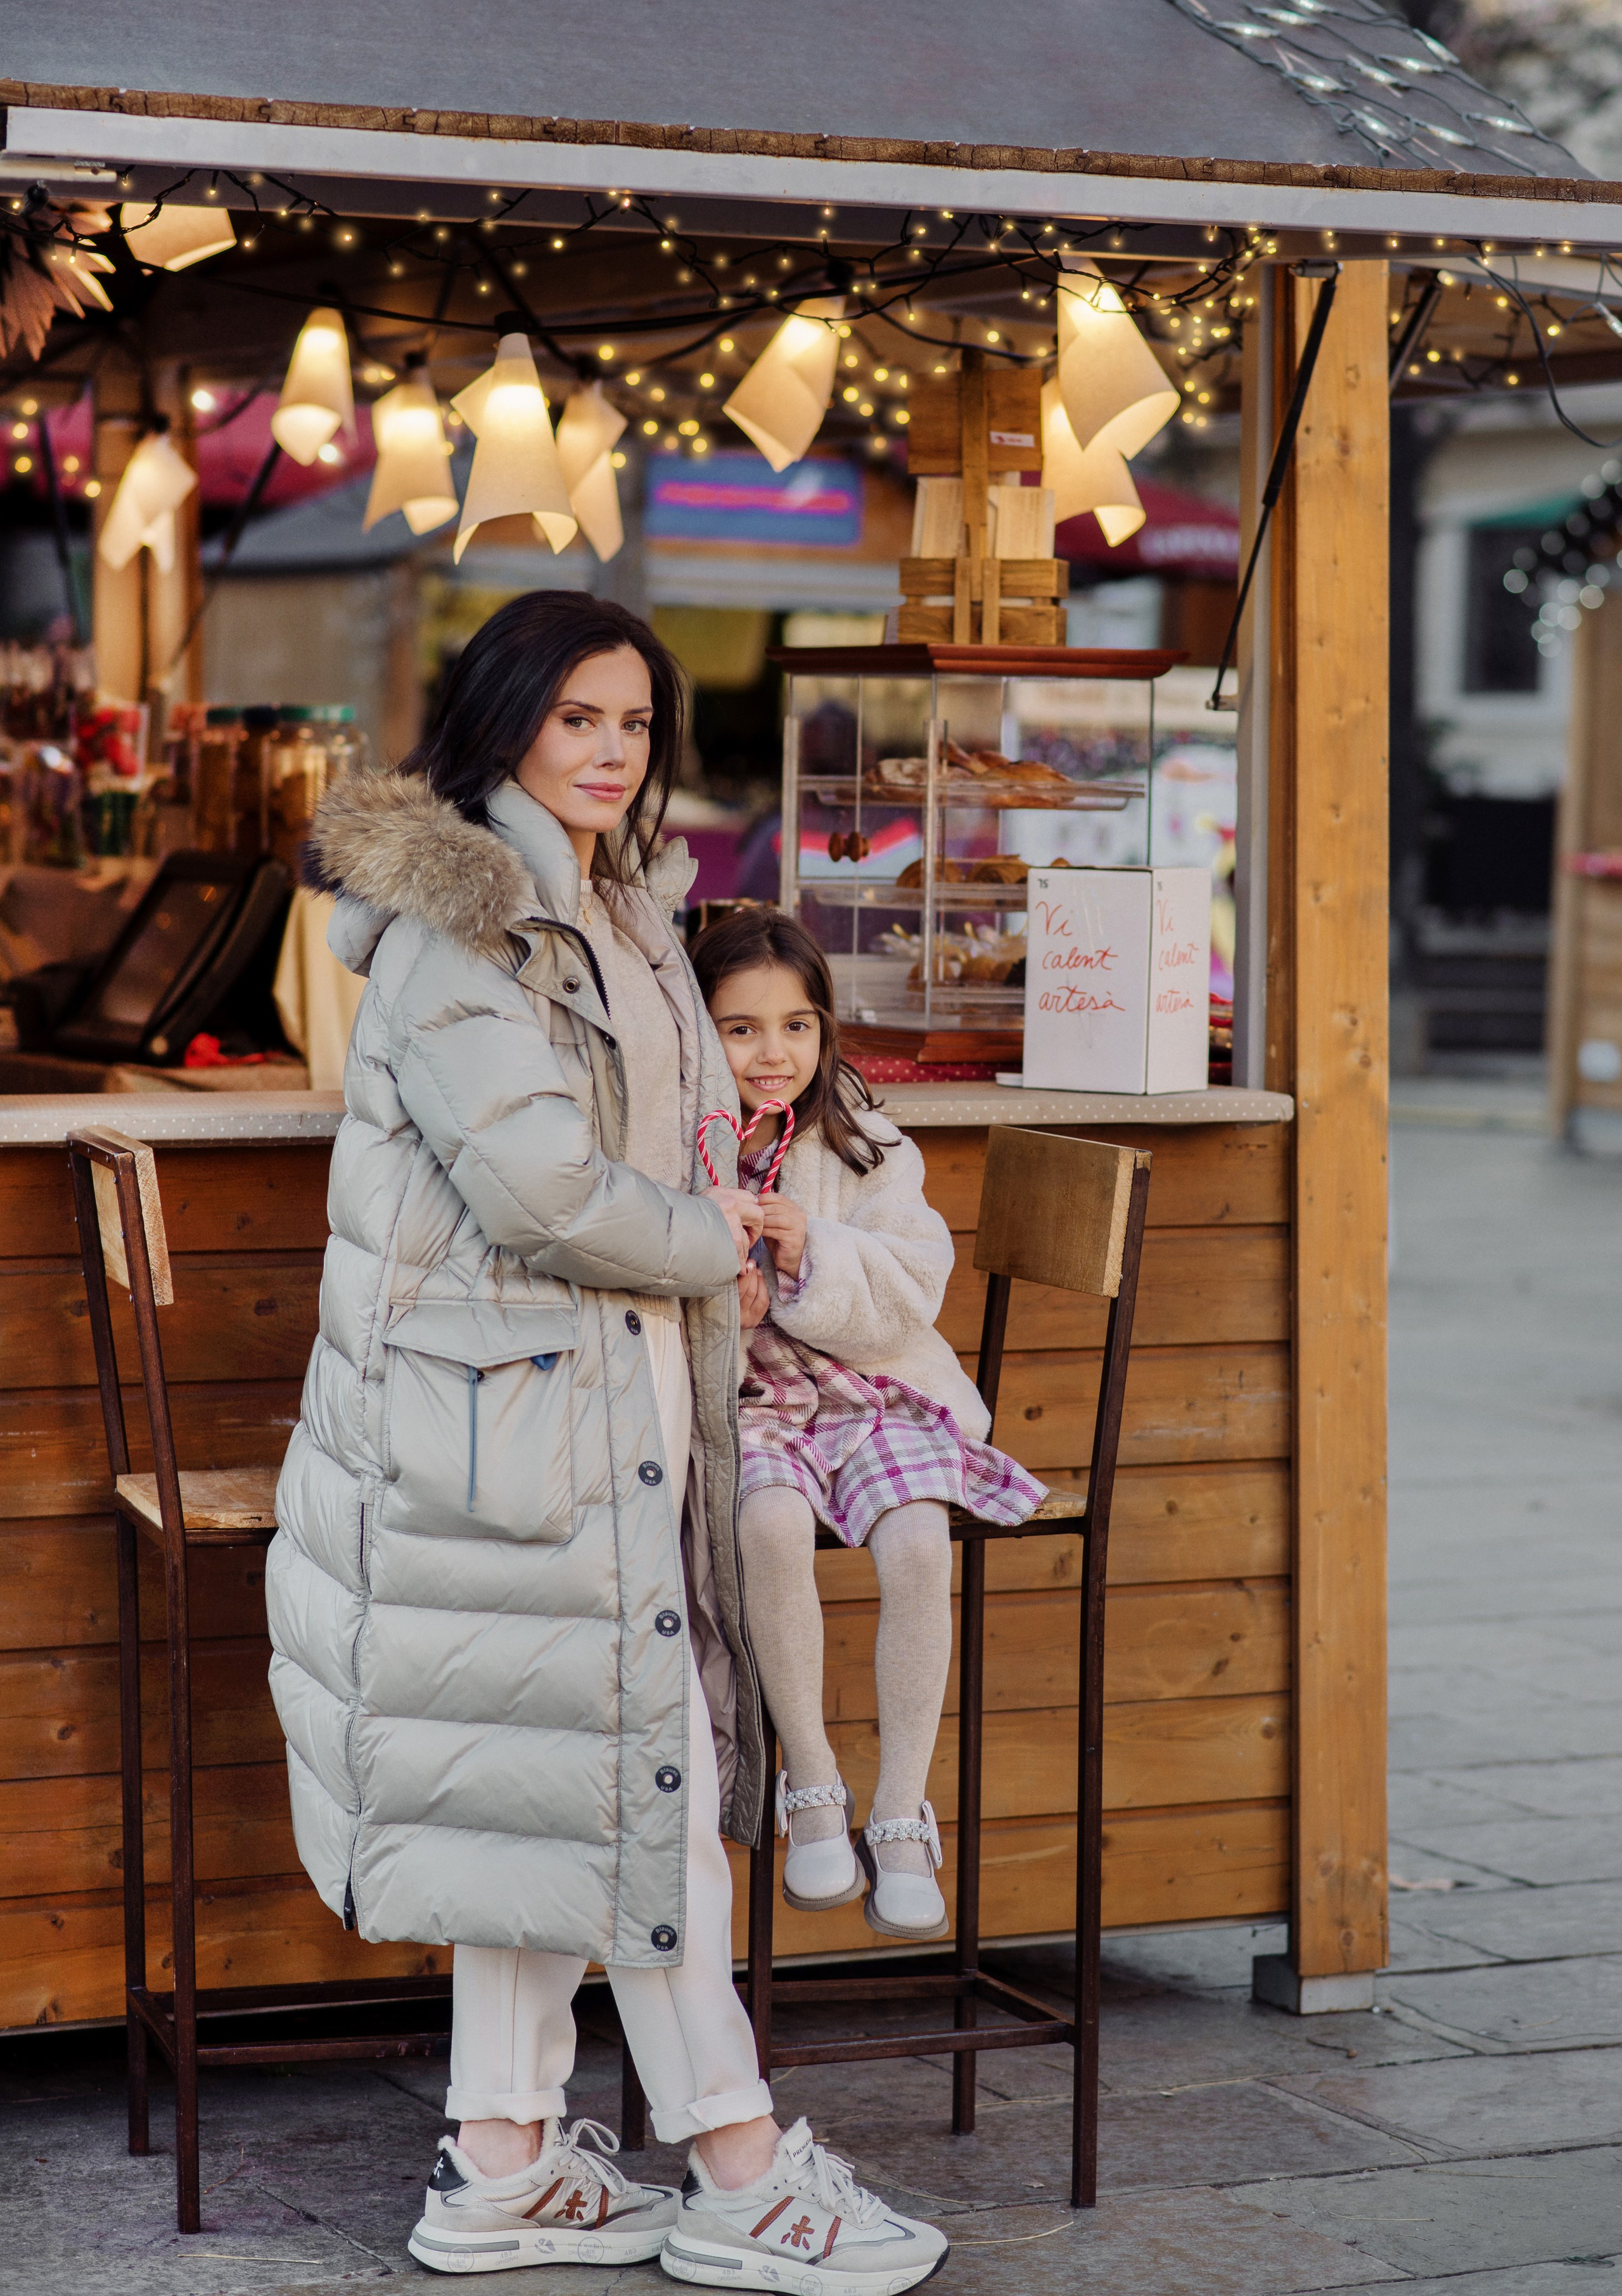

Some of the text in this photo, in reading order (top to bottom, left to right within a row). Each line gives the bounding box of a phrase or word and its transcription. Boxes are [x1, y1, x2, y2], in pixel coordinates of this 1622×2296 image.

[1035, 901, 1074, 937] Vi
[1156, 899, 1175, 935] Vi
[499, 2250, 513, 2259] 483
[620, 2252, 646, 2263] ORIGINAL
[495, 2255, 520, 2266] ORIGINAL
